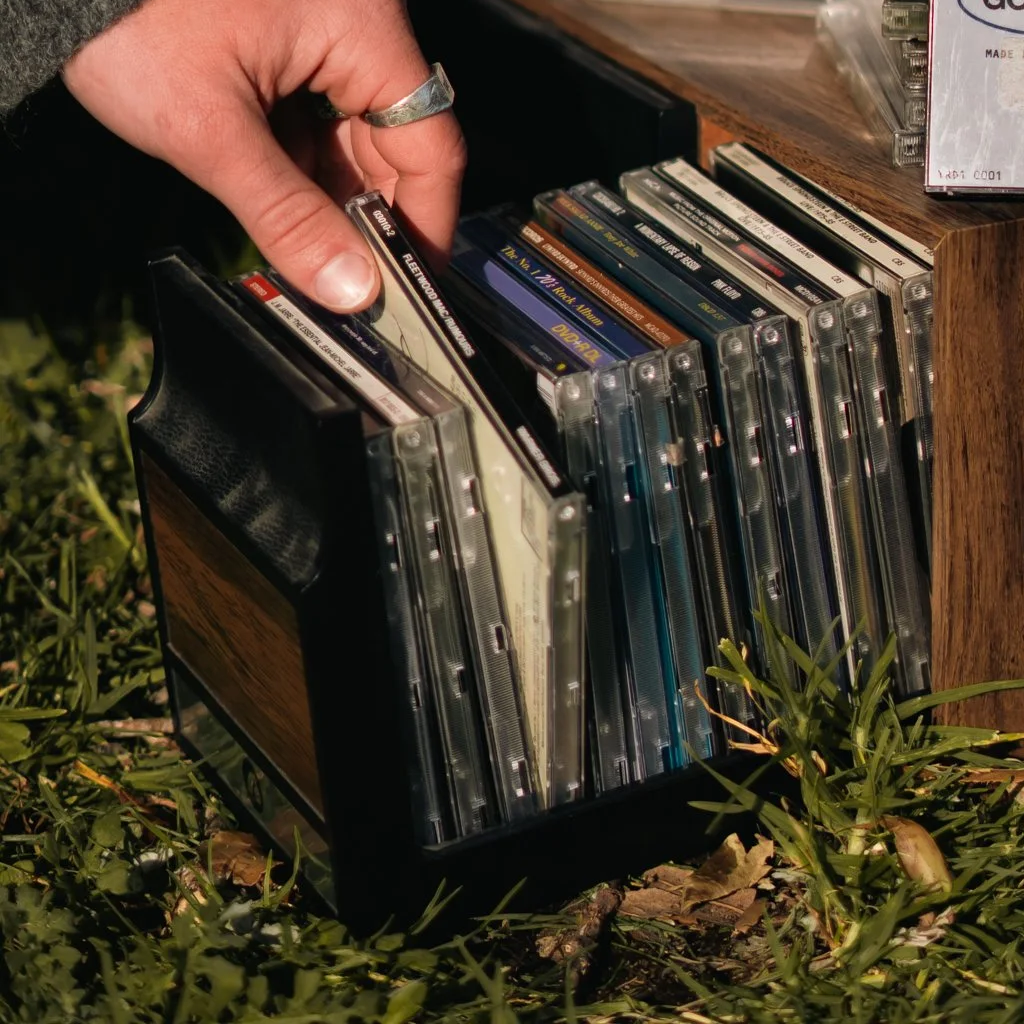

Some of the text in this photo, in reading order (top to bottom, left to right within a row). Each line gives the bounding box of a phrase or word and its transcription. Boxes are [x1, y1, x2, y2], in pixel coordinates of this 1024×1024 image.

[985, 49, 1014, 59] MADE
[373, 210, 394, 235] 03010-2
[403, 254, 436, 299] FLEETWOOD
[501, 246, 517, 258] The
[519, 258, 529, 270] No.
[535, 274, 557, 287] 70's
[552, 286, 575, 303] Rock
[576, 304, 602, 325] Album
[831, 275, 843, 283] CBS
[552, 324, 589, 351] DVD+R
